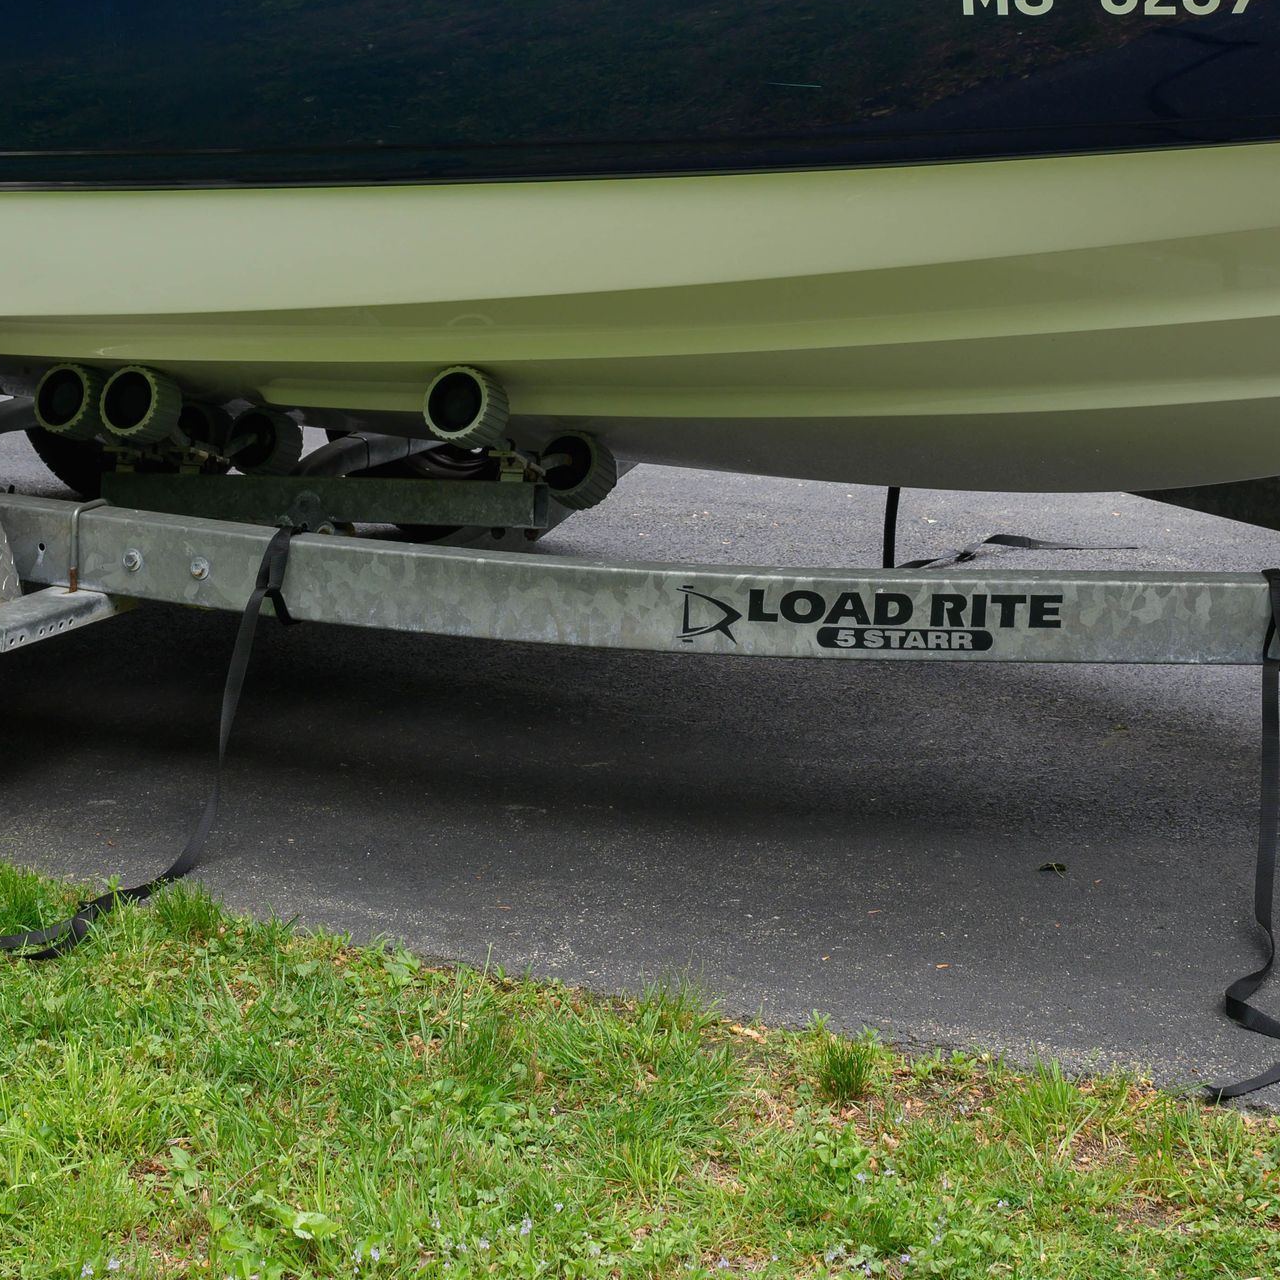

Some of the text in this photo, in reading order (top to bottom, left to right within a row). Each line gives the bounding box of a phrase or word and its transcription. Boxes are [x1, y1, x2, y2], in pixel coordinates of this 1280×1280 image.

[747, 588, 1064, 628] LOAD RITE
[834, 629, 974, 650] 5 STARR
